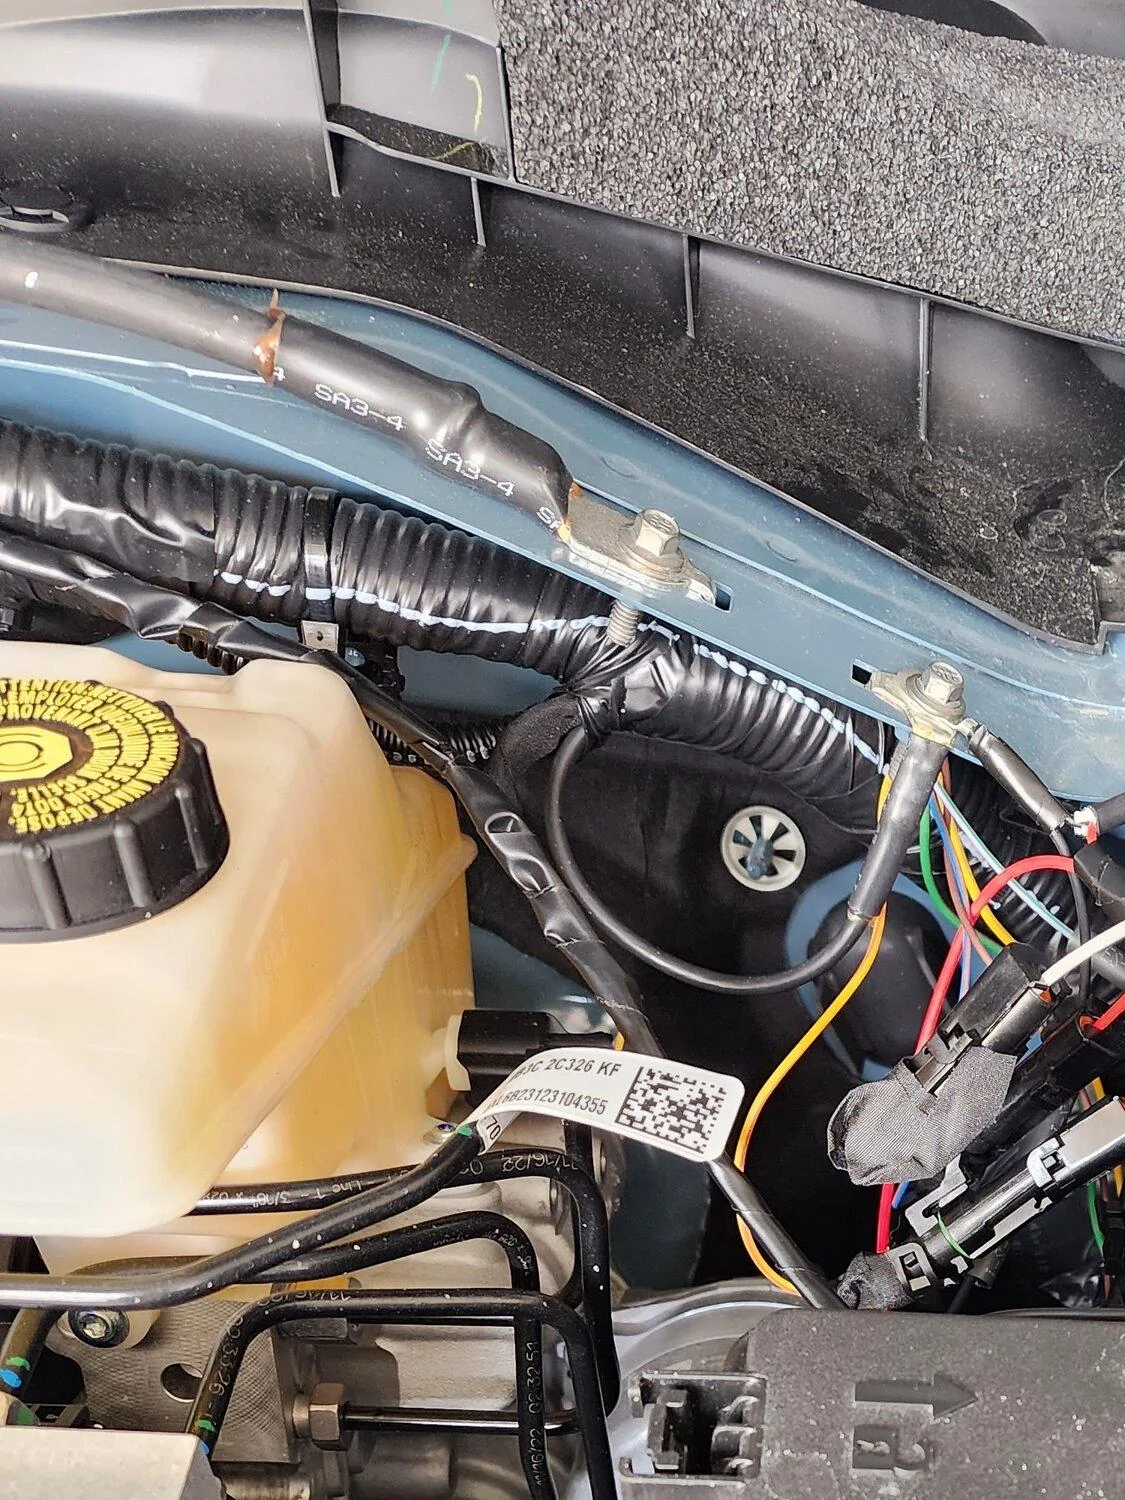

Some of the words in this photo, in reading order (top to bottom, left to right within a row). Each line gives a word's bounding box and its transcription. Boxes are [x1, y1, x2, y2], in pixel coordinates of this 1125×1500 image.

[314, 383, 407, 432] SA3-4
[425, 438, 516, 497] SA3-4
[545, 1057, 594, 1072] 2C326
[597, 1061, 622, 1077] KF
[502, 1153, 580, 1173] 11/16/22
[332, 1179, 363, 1193] Line
